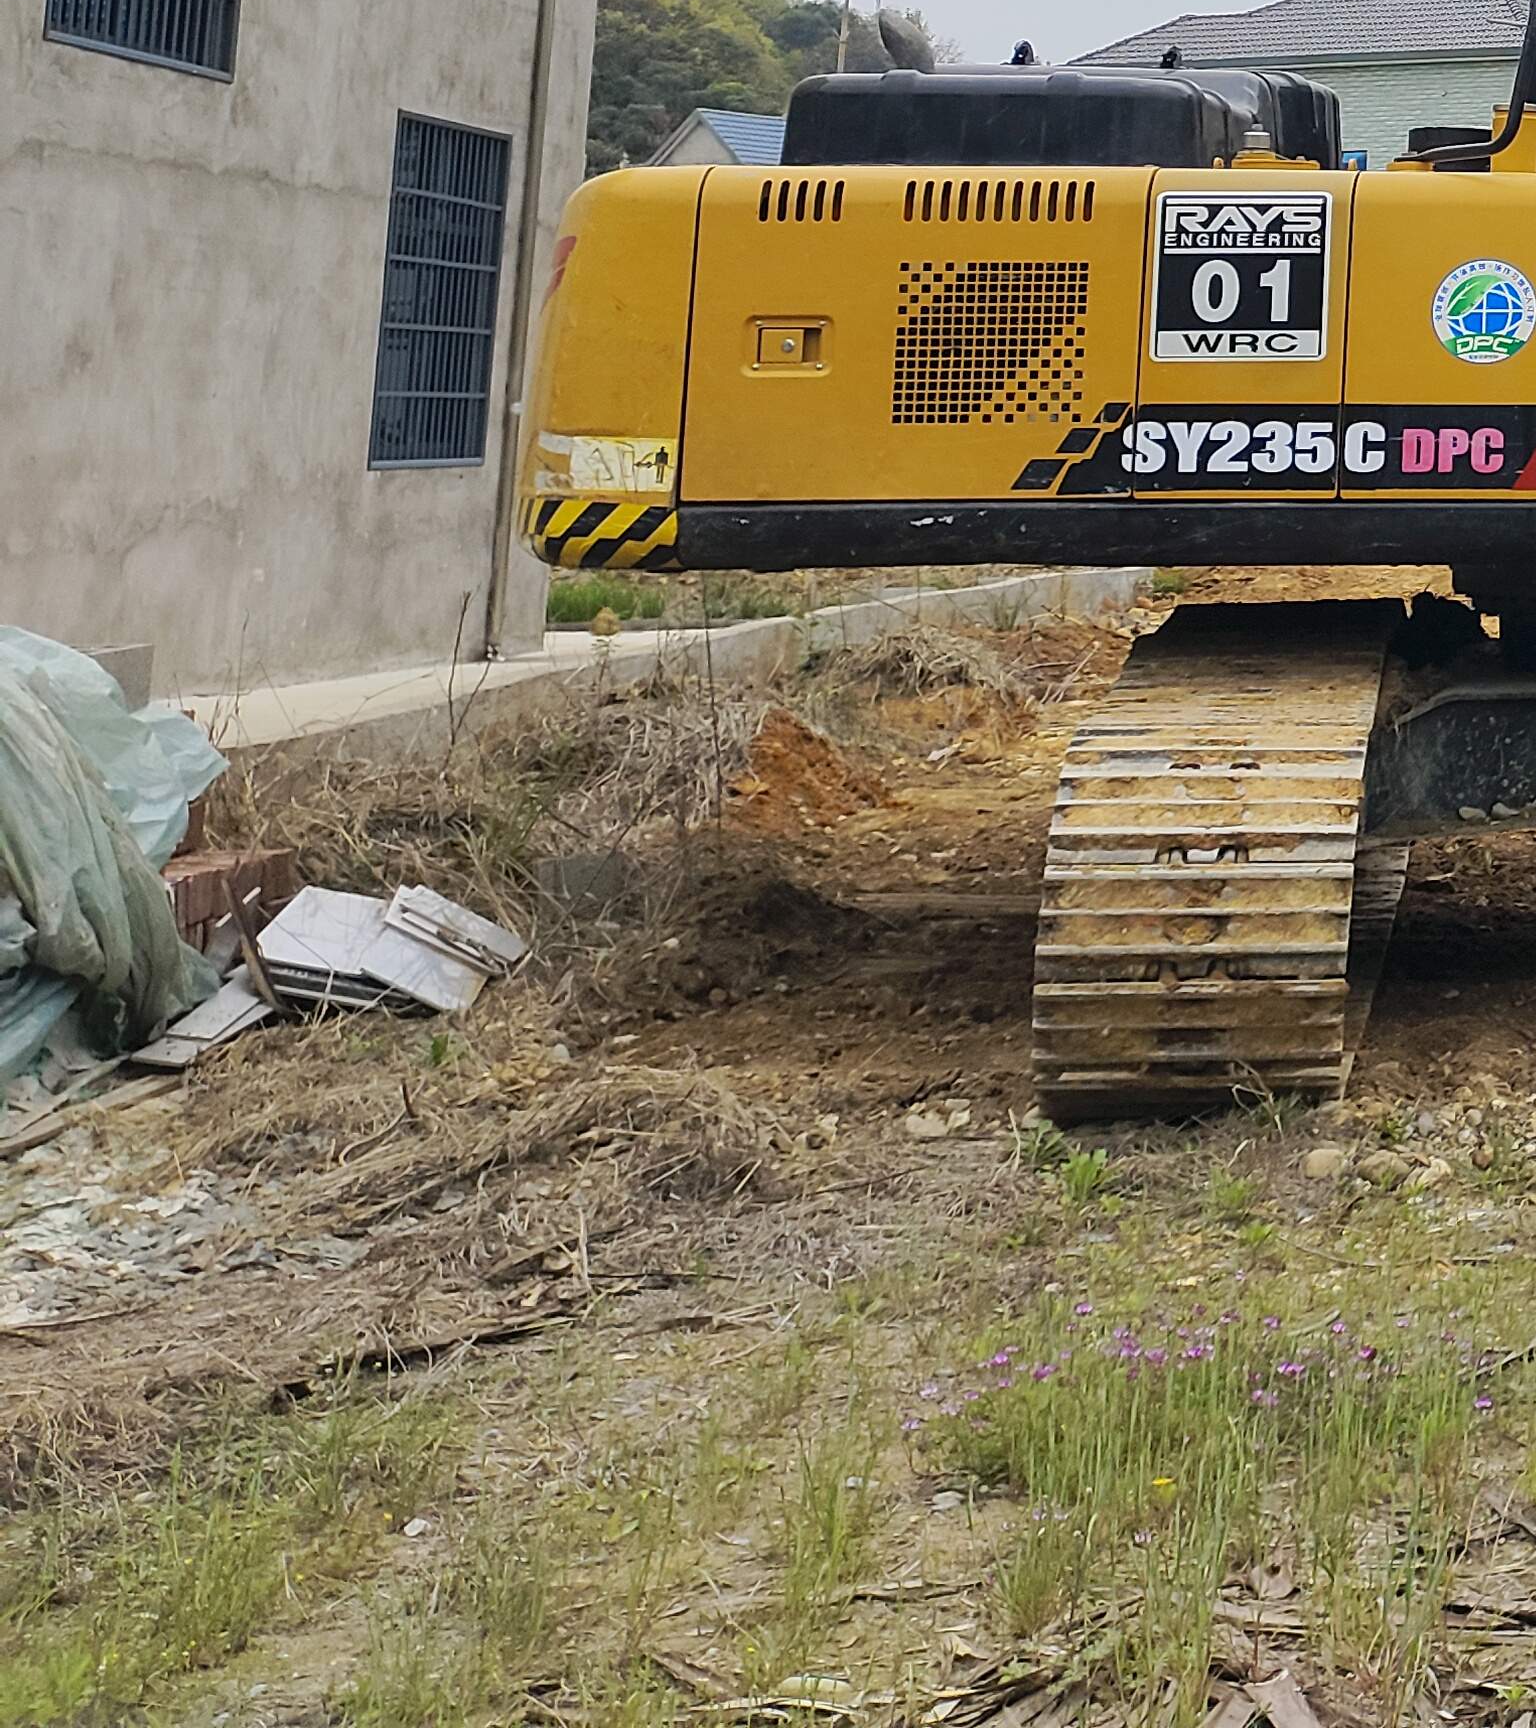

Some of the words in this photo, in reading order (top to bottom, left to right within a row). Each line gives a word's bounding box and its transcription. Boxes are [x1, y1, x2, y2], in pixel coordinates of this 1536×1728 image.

[1165, 206, 1322, 232] RAYS
[1164, 233, 1321, 247] ENGINEERING
[1182, 333, 1299, 353] WRC
[1456, 336, 1514, 354] DPC
[1122, 421, 1386, 473] SY235C
[1402, 428, 1504, 473] DPC
